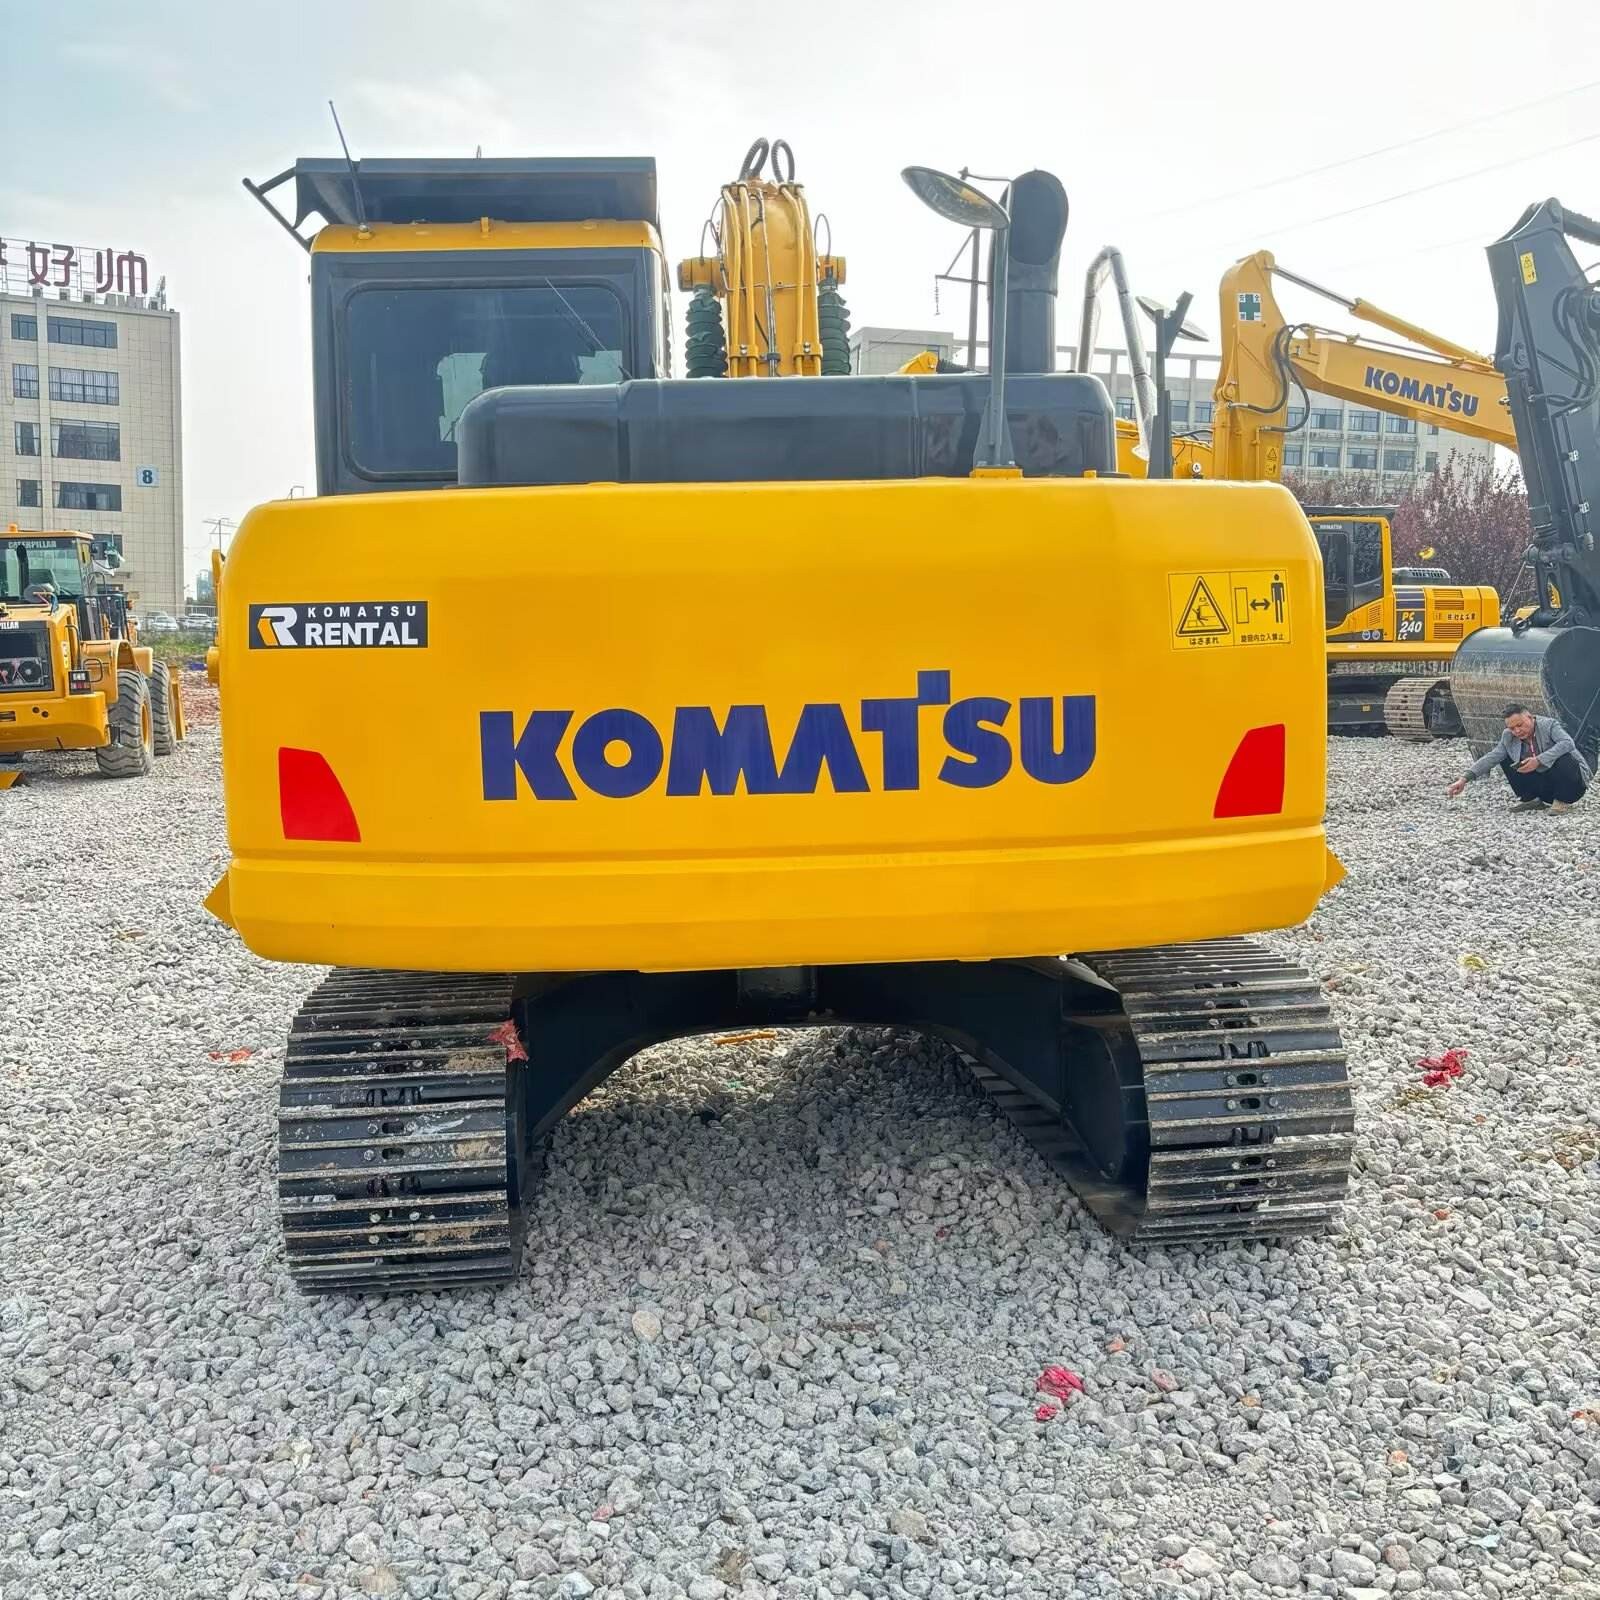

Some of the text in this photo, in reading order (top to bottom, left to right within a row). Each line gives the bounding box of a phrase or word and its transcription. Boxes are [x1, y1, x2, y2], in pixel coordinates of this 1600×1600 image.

[0, 237, 147, 296] 好帅
[1364, 366, 1479, 417] KOMATSU
[142, 469, 153, 484] 8
[307, 605, 417, 619] KOMATSU
[1402, 611, 1416, 621] PC
[305, 621, 419, 646] RENTAL
[1400, 621, 1423, 633] 240
[1397, 633, 1408, 641] LC
[479, 669, 1097, 801] KOMATSU
